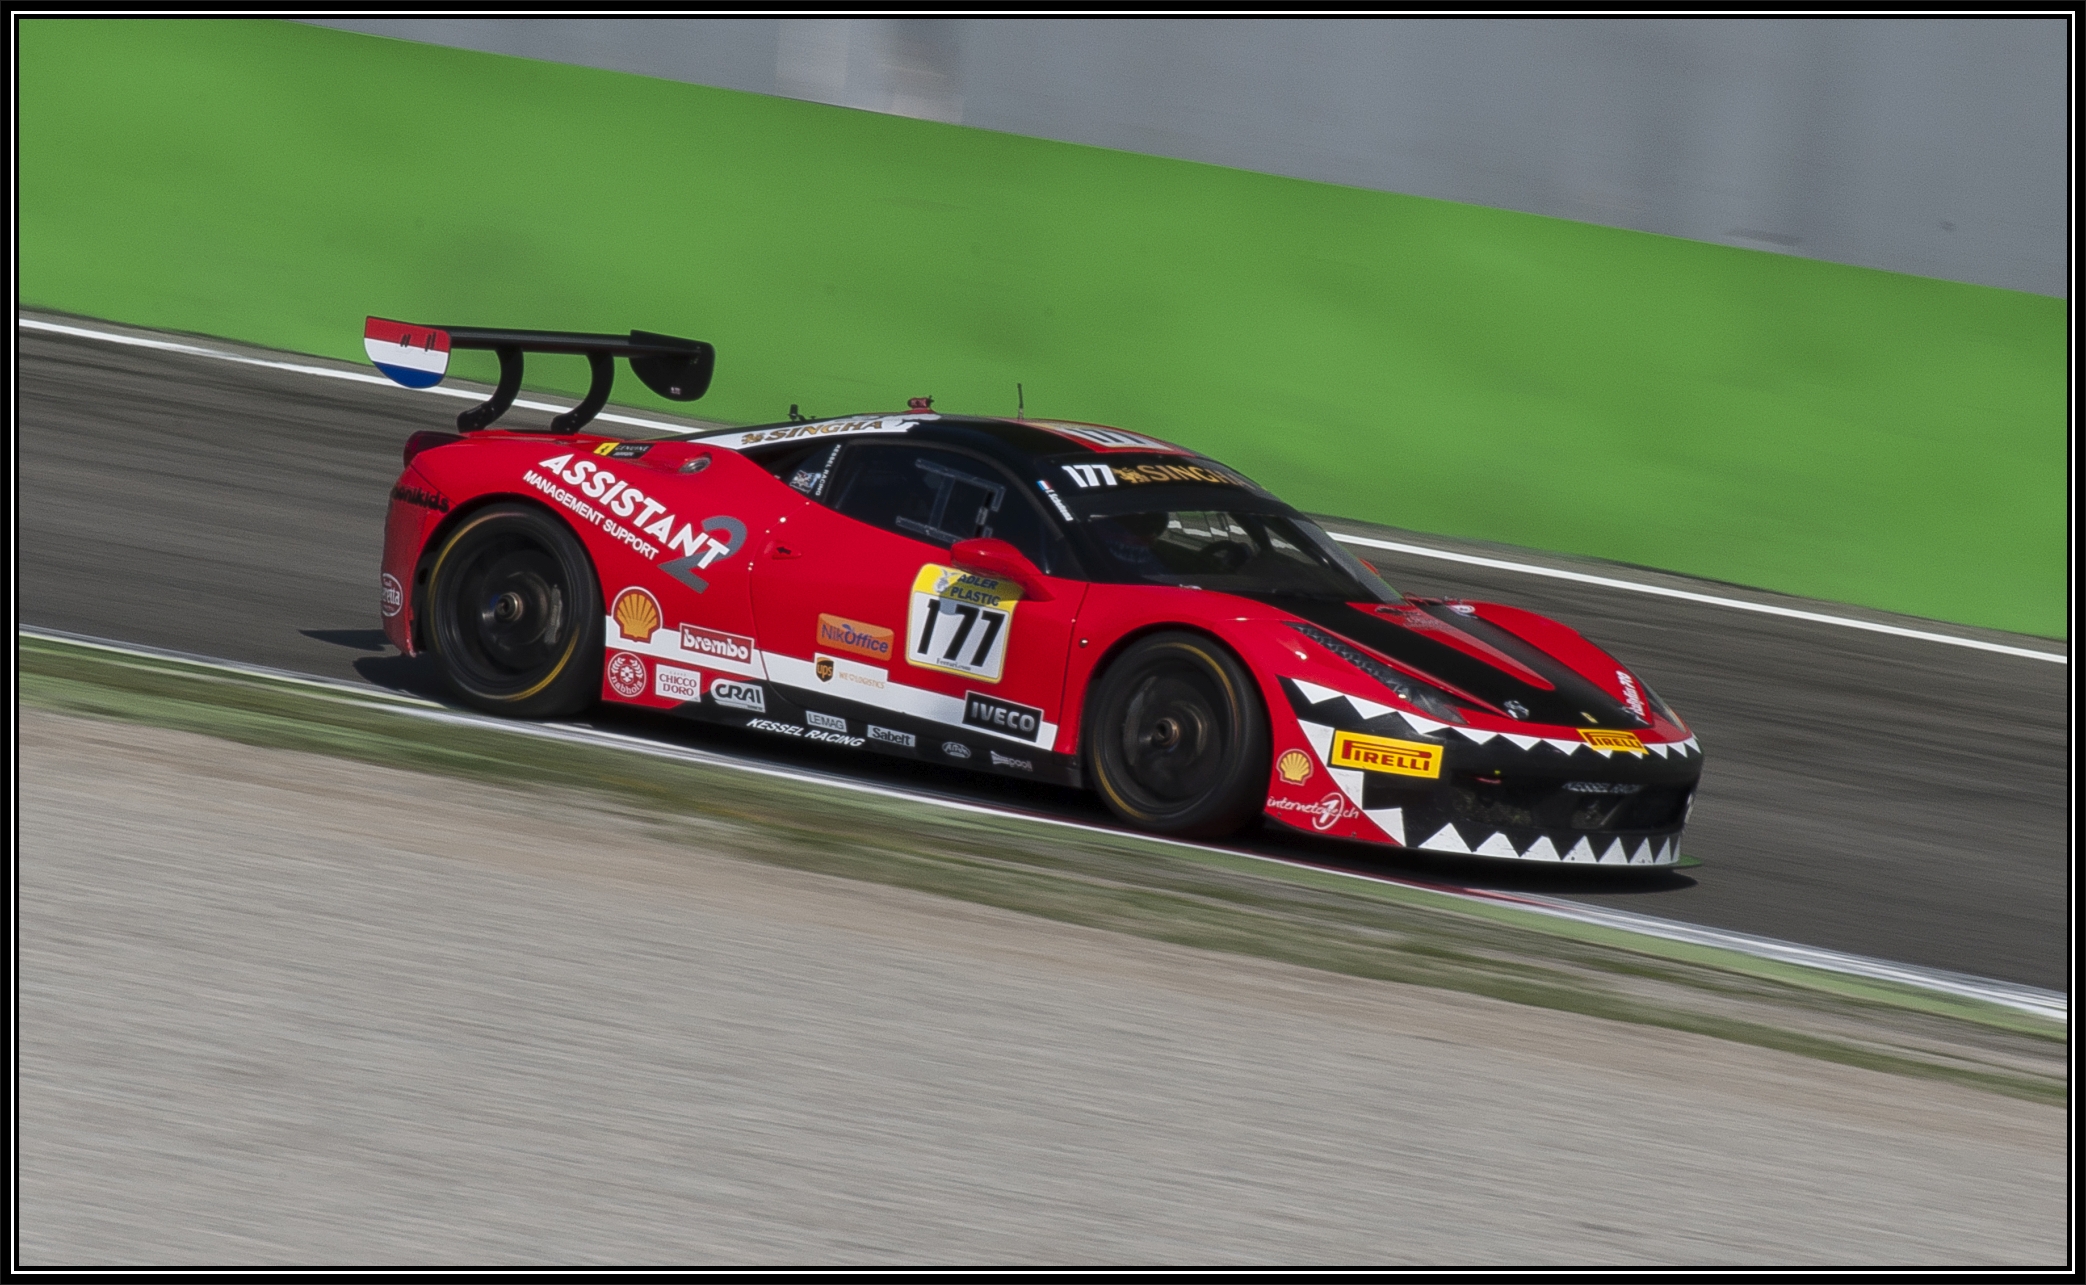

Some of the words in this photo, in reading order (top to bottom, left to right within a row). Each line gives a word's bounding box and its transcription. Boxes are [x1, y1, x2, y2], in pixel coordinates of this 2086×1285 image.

[765, 420, 883, 441] SINGHA
[1061, 464, 1118, 488] 177
[1137, 465, 1257, 491] SINGHA
[522, 470, 605, 526] MANAGEMENT
[602, 519, 660, 560] SUPPORT
[538, 453, 731, 569] ASSISTANT
[657, 515, 748, 594] 2
[957, 574, 999, 590] ADLER
[950, 587, 1001, 607] PLASTIC
[684, 629, 749, 660] brembo
[821, 624, 889, 654] NikOffice
[917, 598, 1006, 668] 177
[659, 673, 697, 688] CHICCO
[816, 662, 834, 679] ups
[715, 684, 762, 704] CRAI
[971, 701, 1036, 732] IVECO
[746, 718, 804, 737] KESSEL
[805, 729, 865, 747] RACING
[872, 728, 912, 746] Sabelt
[1584, 732, 1643, 749] PIRELLI
[1341, 739, 1433, 771] PIRELLI
